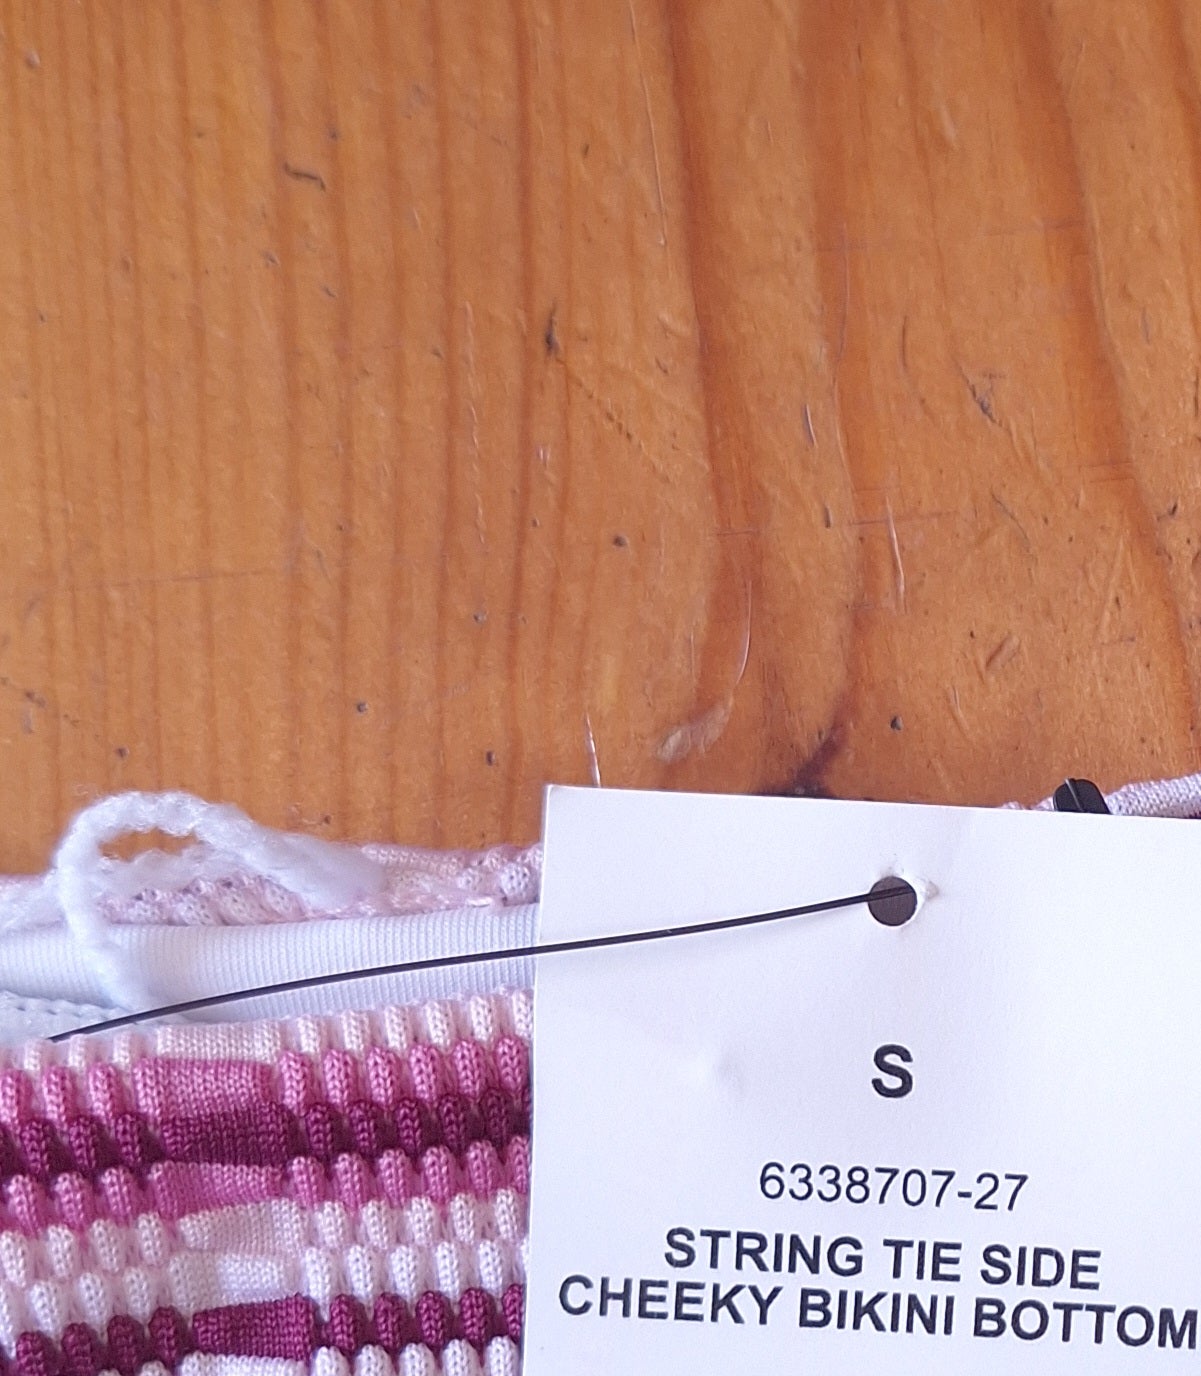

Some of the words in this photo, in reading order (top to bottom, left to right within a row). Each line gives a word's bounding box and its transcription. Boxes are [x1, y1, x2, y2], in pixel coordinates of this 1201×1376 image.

[872, 1045, 912, 1098] S
[760, 1162, 1028, 1211] 6338707-27
[665, 1228, 862, 1277] STRING
[883, 1239, 962, 1282] TIE
[981, 1244, 1101, 1290] SIDE
[559, 1275, 782, 1325] CHEEKY
[799, 1288, 954, 1335] BIKINI
[974, 1298, 1197, 1349] BOTTOM
